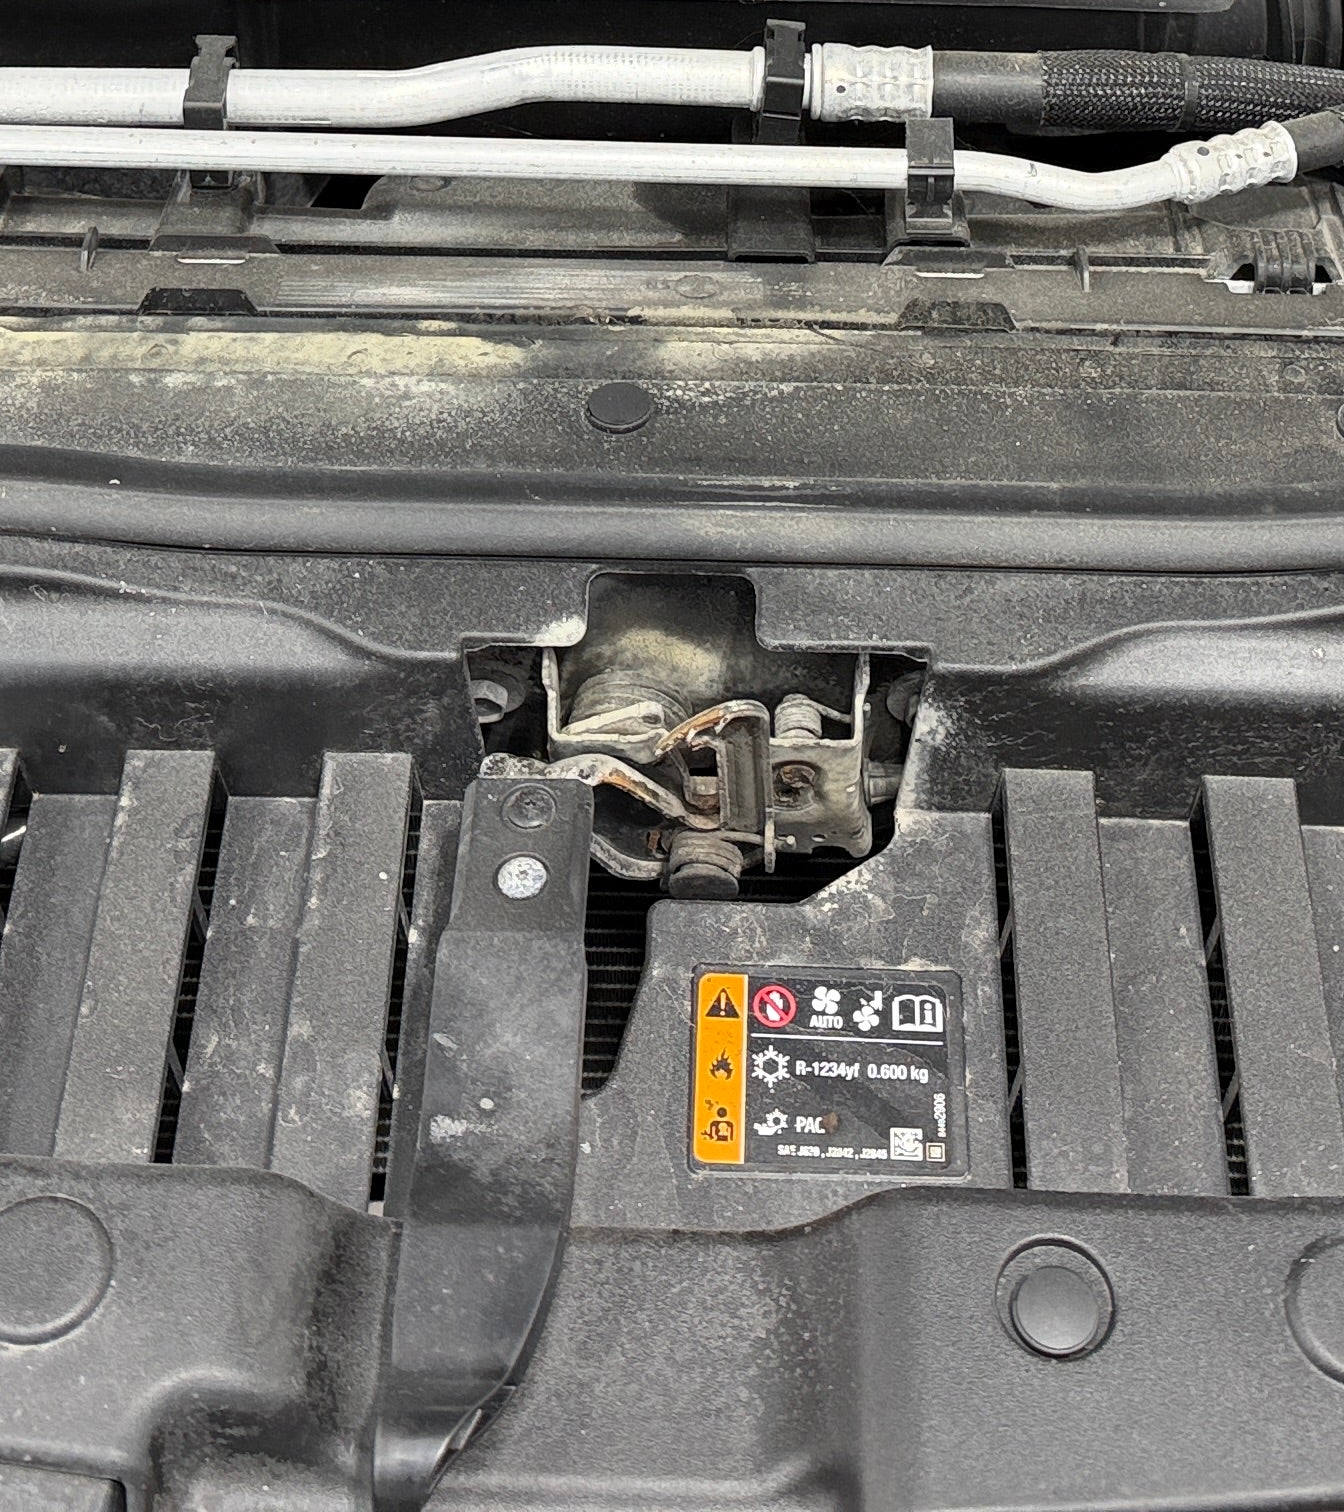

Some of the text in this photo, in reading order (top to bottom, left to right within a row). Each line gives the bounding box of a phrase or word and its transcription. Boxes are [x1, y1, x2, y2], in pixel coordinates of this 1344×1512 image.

[809, 1015, 843, 1029] AUTO
[796, 1060, 929, 1084] R-1234yf 0.600 kg
